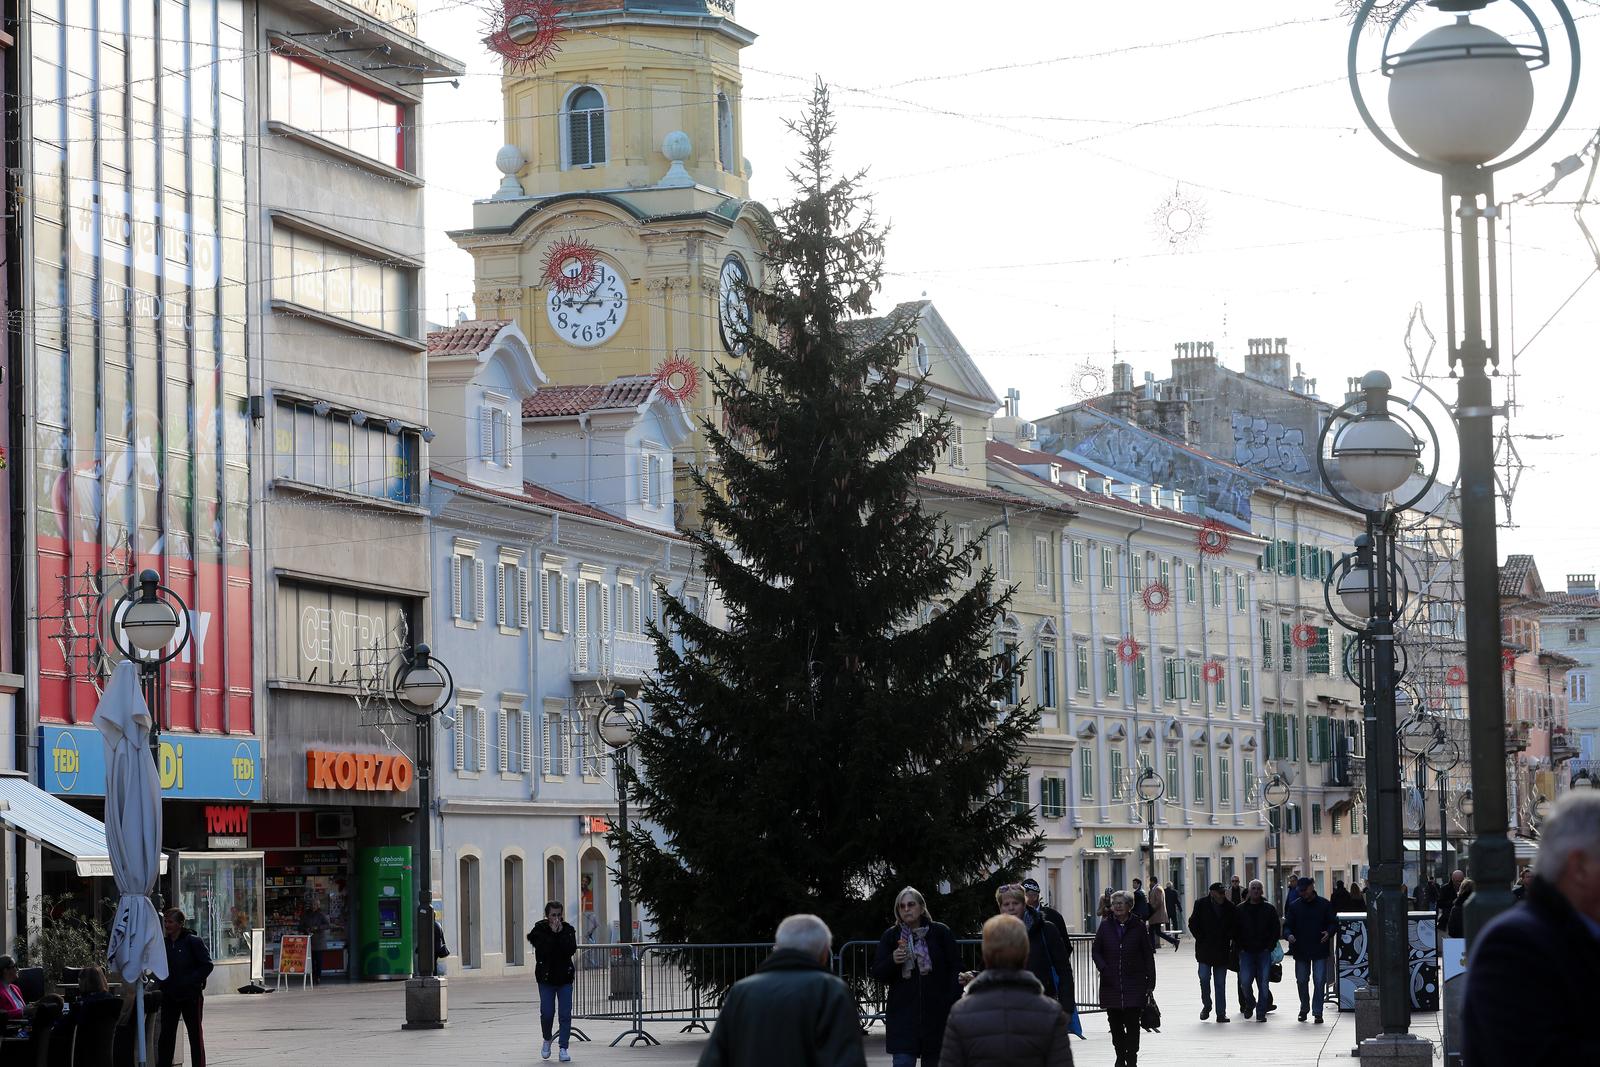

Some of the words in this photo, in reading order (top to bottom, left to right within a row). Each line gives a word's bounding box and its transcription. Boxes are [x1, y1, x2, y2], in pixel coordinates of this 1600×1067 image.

[607, 275, 616, 292] 2
[551, 295, 562, 312] 9
[613, 291, 623, 309] 3
[557, 312, 568, 329] 8
[606, 308, 617, 324] 4
[570, 323, 581, 339] 7
[582, 325, 593, 342] 6
[596, 320, 607, 338] 5
[53, 748, 80, 774] TEDi
[232, 757, 255, 781] TEDi
[308, 751, 413, 791] KORZO
[205, 806, 249, 833] TOMMY
